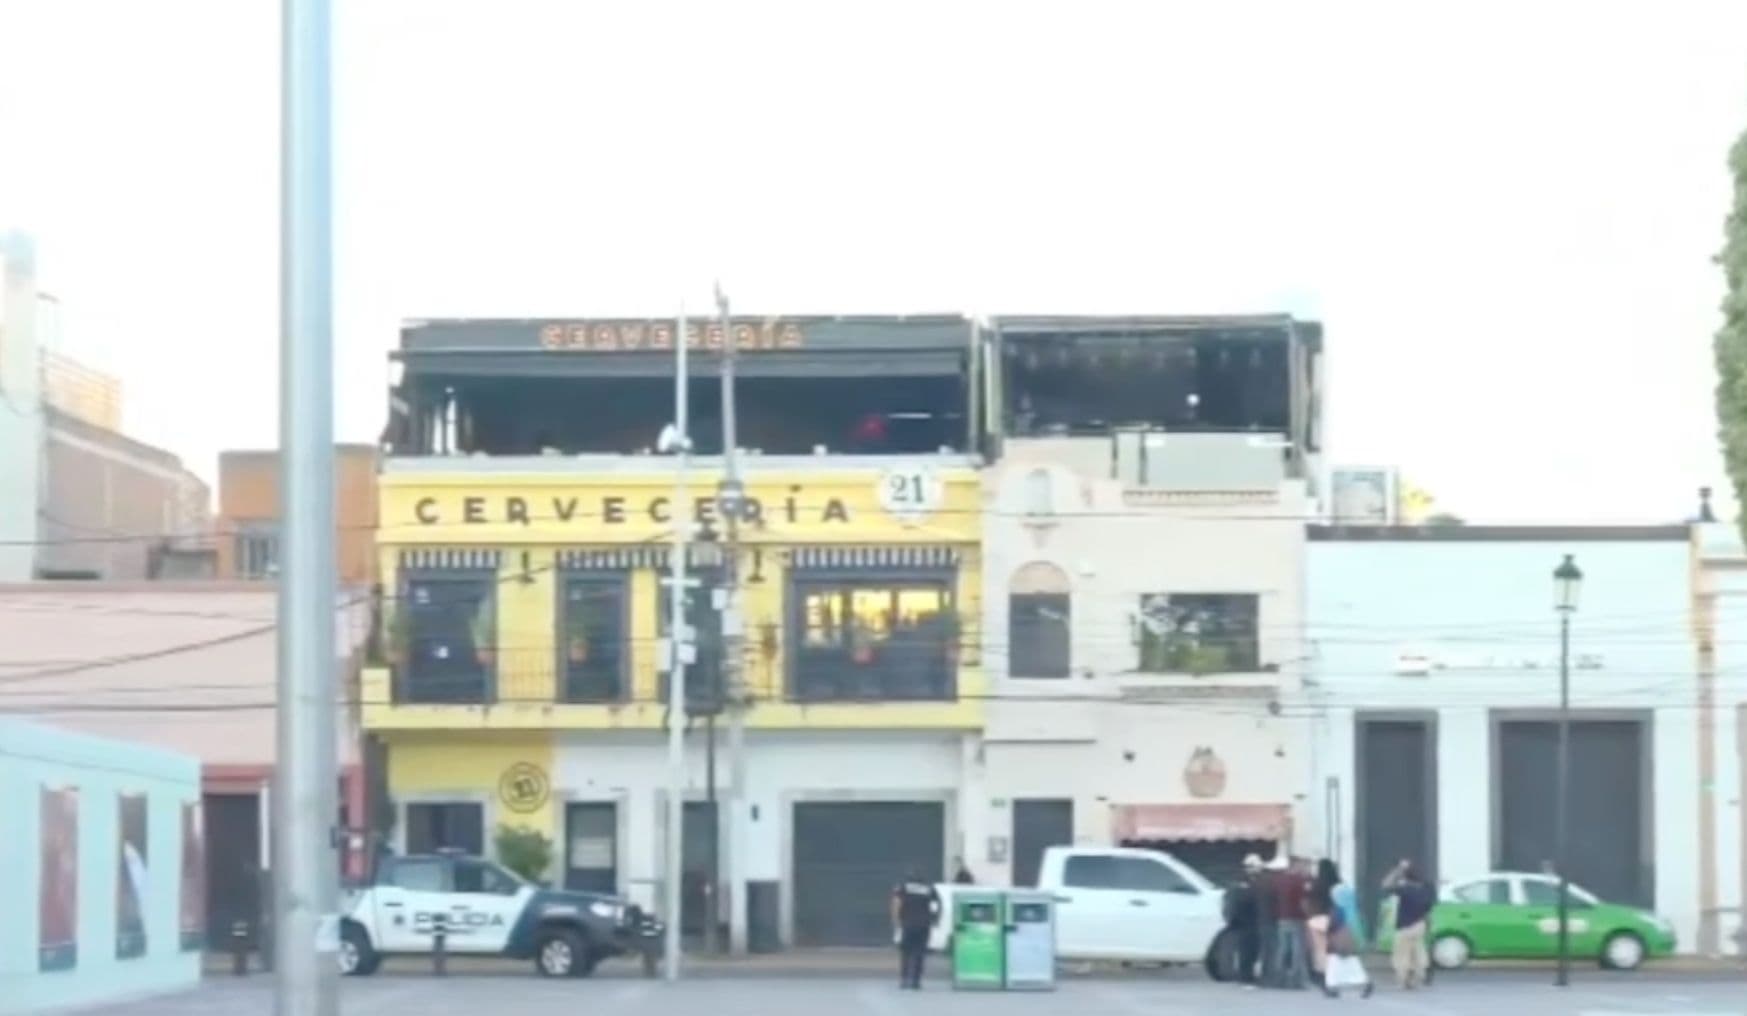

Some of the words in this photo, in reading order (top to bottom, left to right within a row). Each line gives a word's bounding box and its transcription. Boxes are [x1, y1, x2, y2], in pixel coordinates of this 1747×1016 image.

[891, 474, 924, 503] 21
[415, 484, 848, 527] CERVECERÍA
[414, 912, 504, 926] PLICIA
